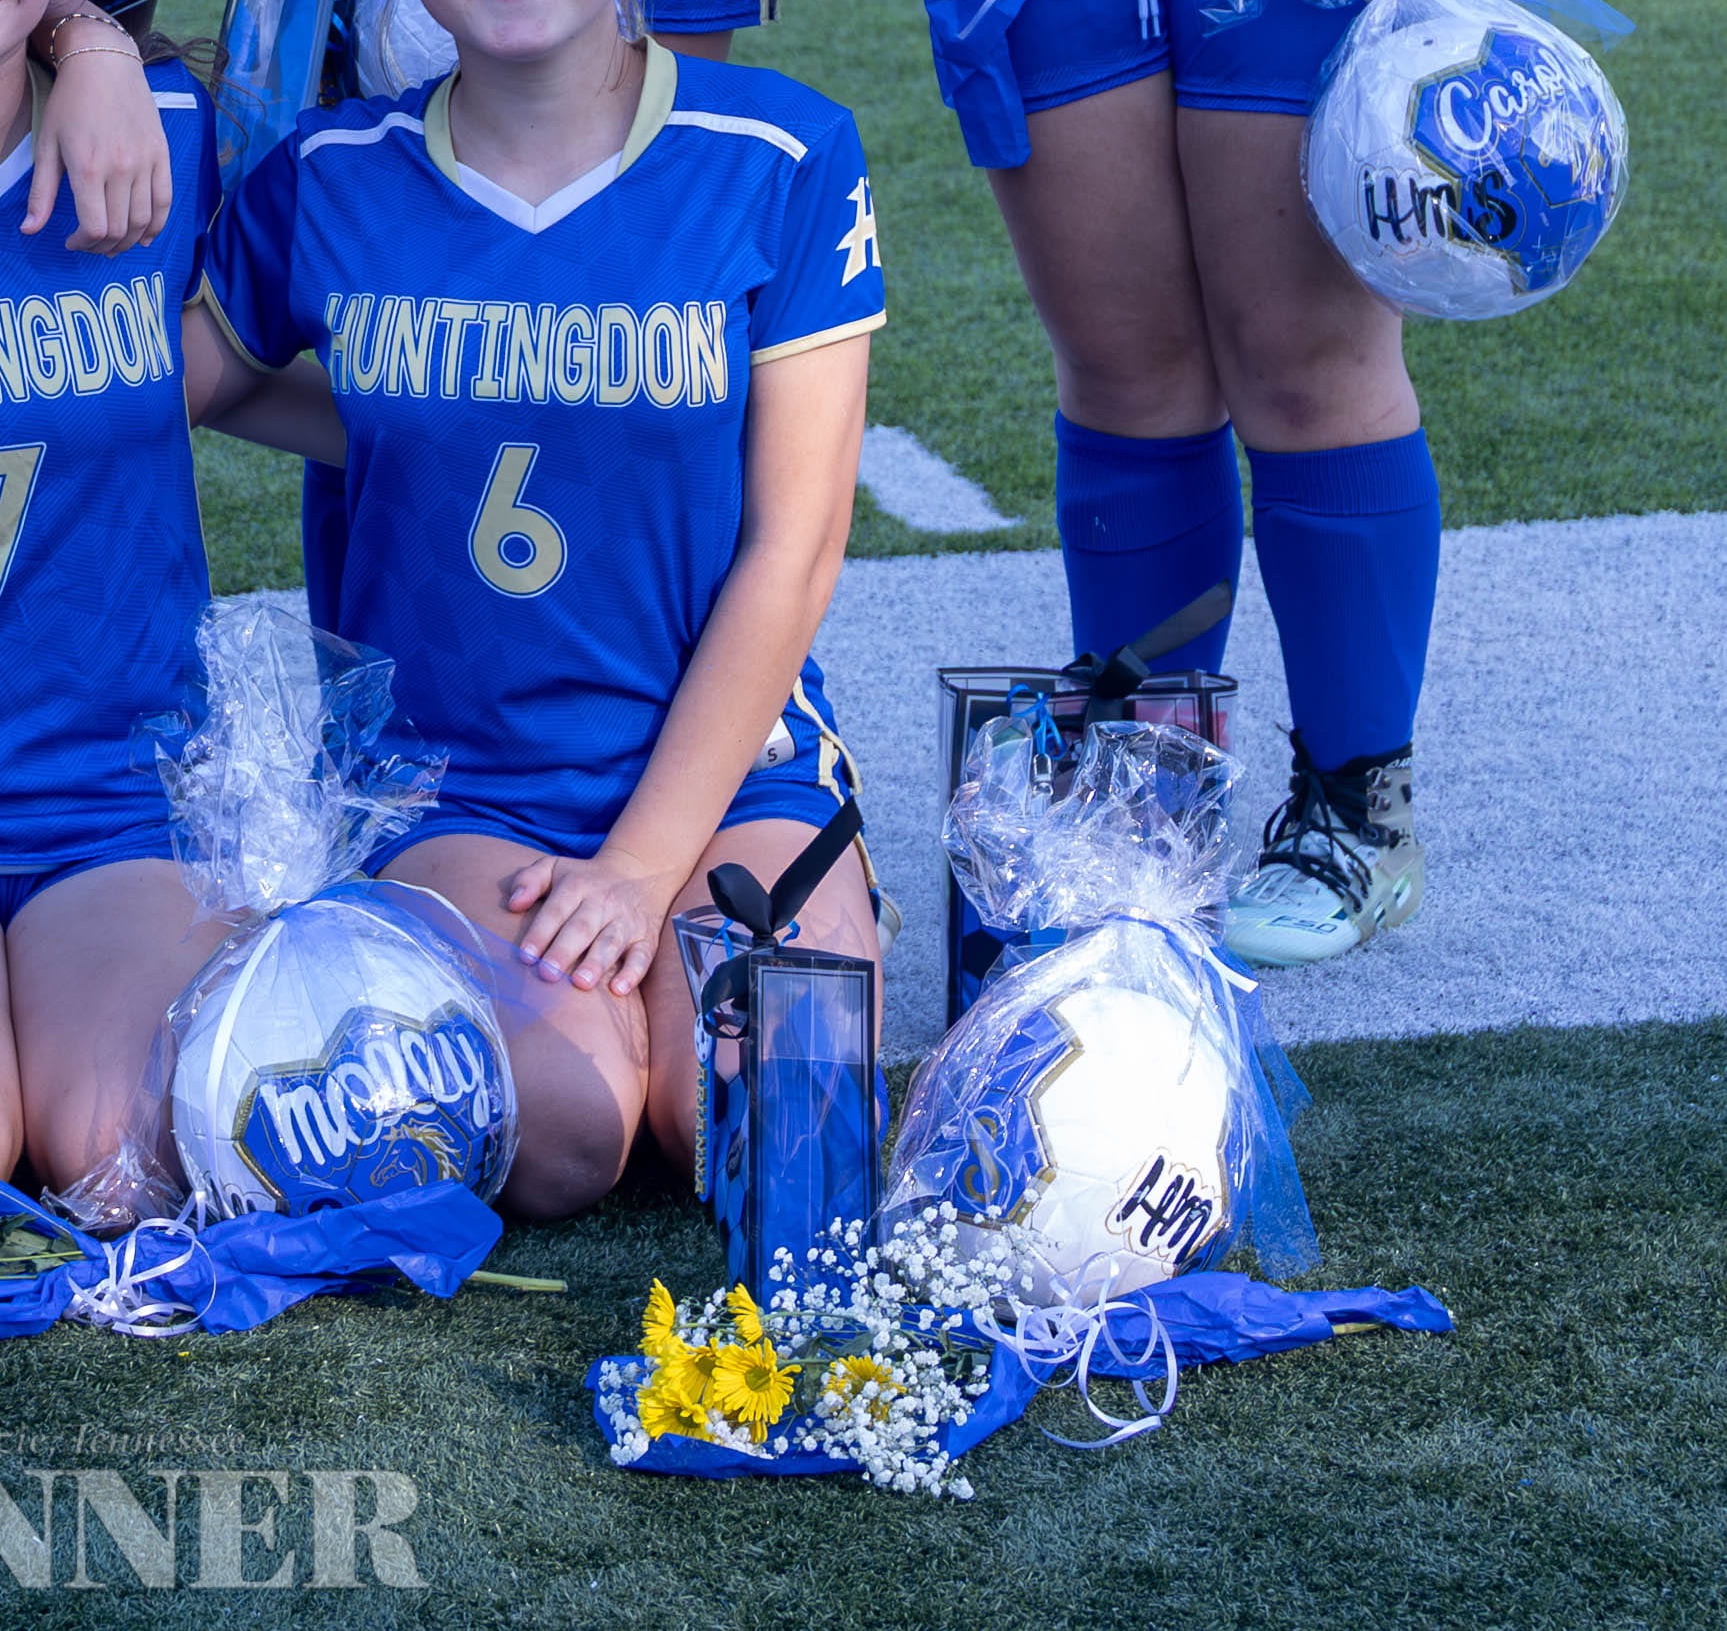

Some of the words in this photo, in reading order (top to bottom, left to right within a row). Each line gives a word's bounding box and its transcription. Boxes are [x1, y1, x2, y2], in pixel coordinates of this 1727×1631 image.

[324, 293, 728, 408] HUNTINGDON
[468, 442, 567, 599] 6
[767, 747, 778, 763] S
